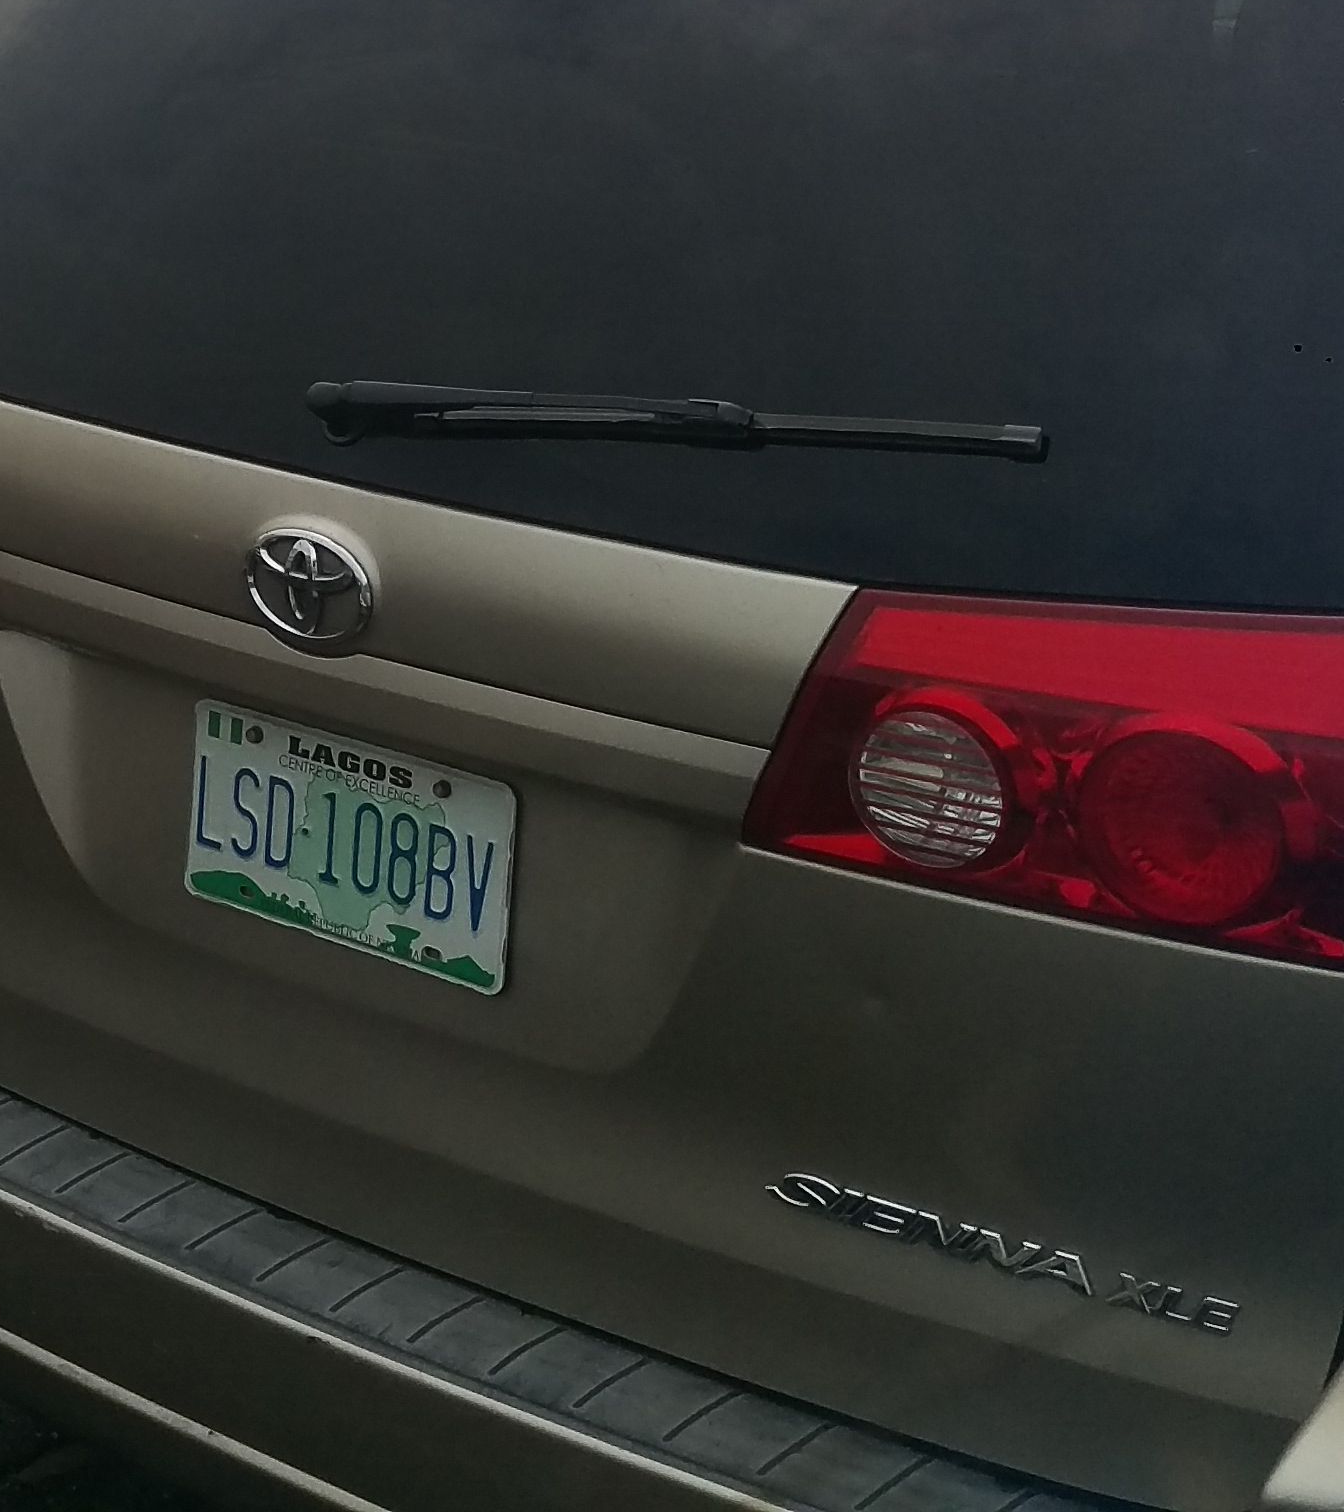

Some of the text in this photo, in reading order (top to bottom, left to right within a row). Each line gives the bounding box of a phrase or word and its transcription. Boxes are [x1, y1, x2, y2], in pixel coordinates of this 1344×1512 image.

[278, 754, 421, 806] CENTRE OF EXCELLENCE
[288, 735, 413, 789] LAGOS
[765, 1172, 1241, 1337] SIENNA XLE
